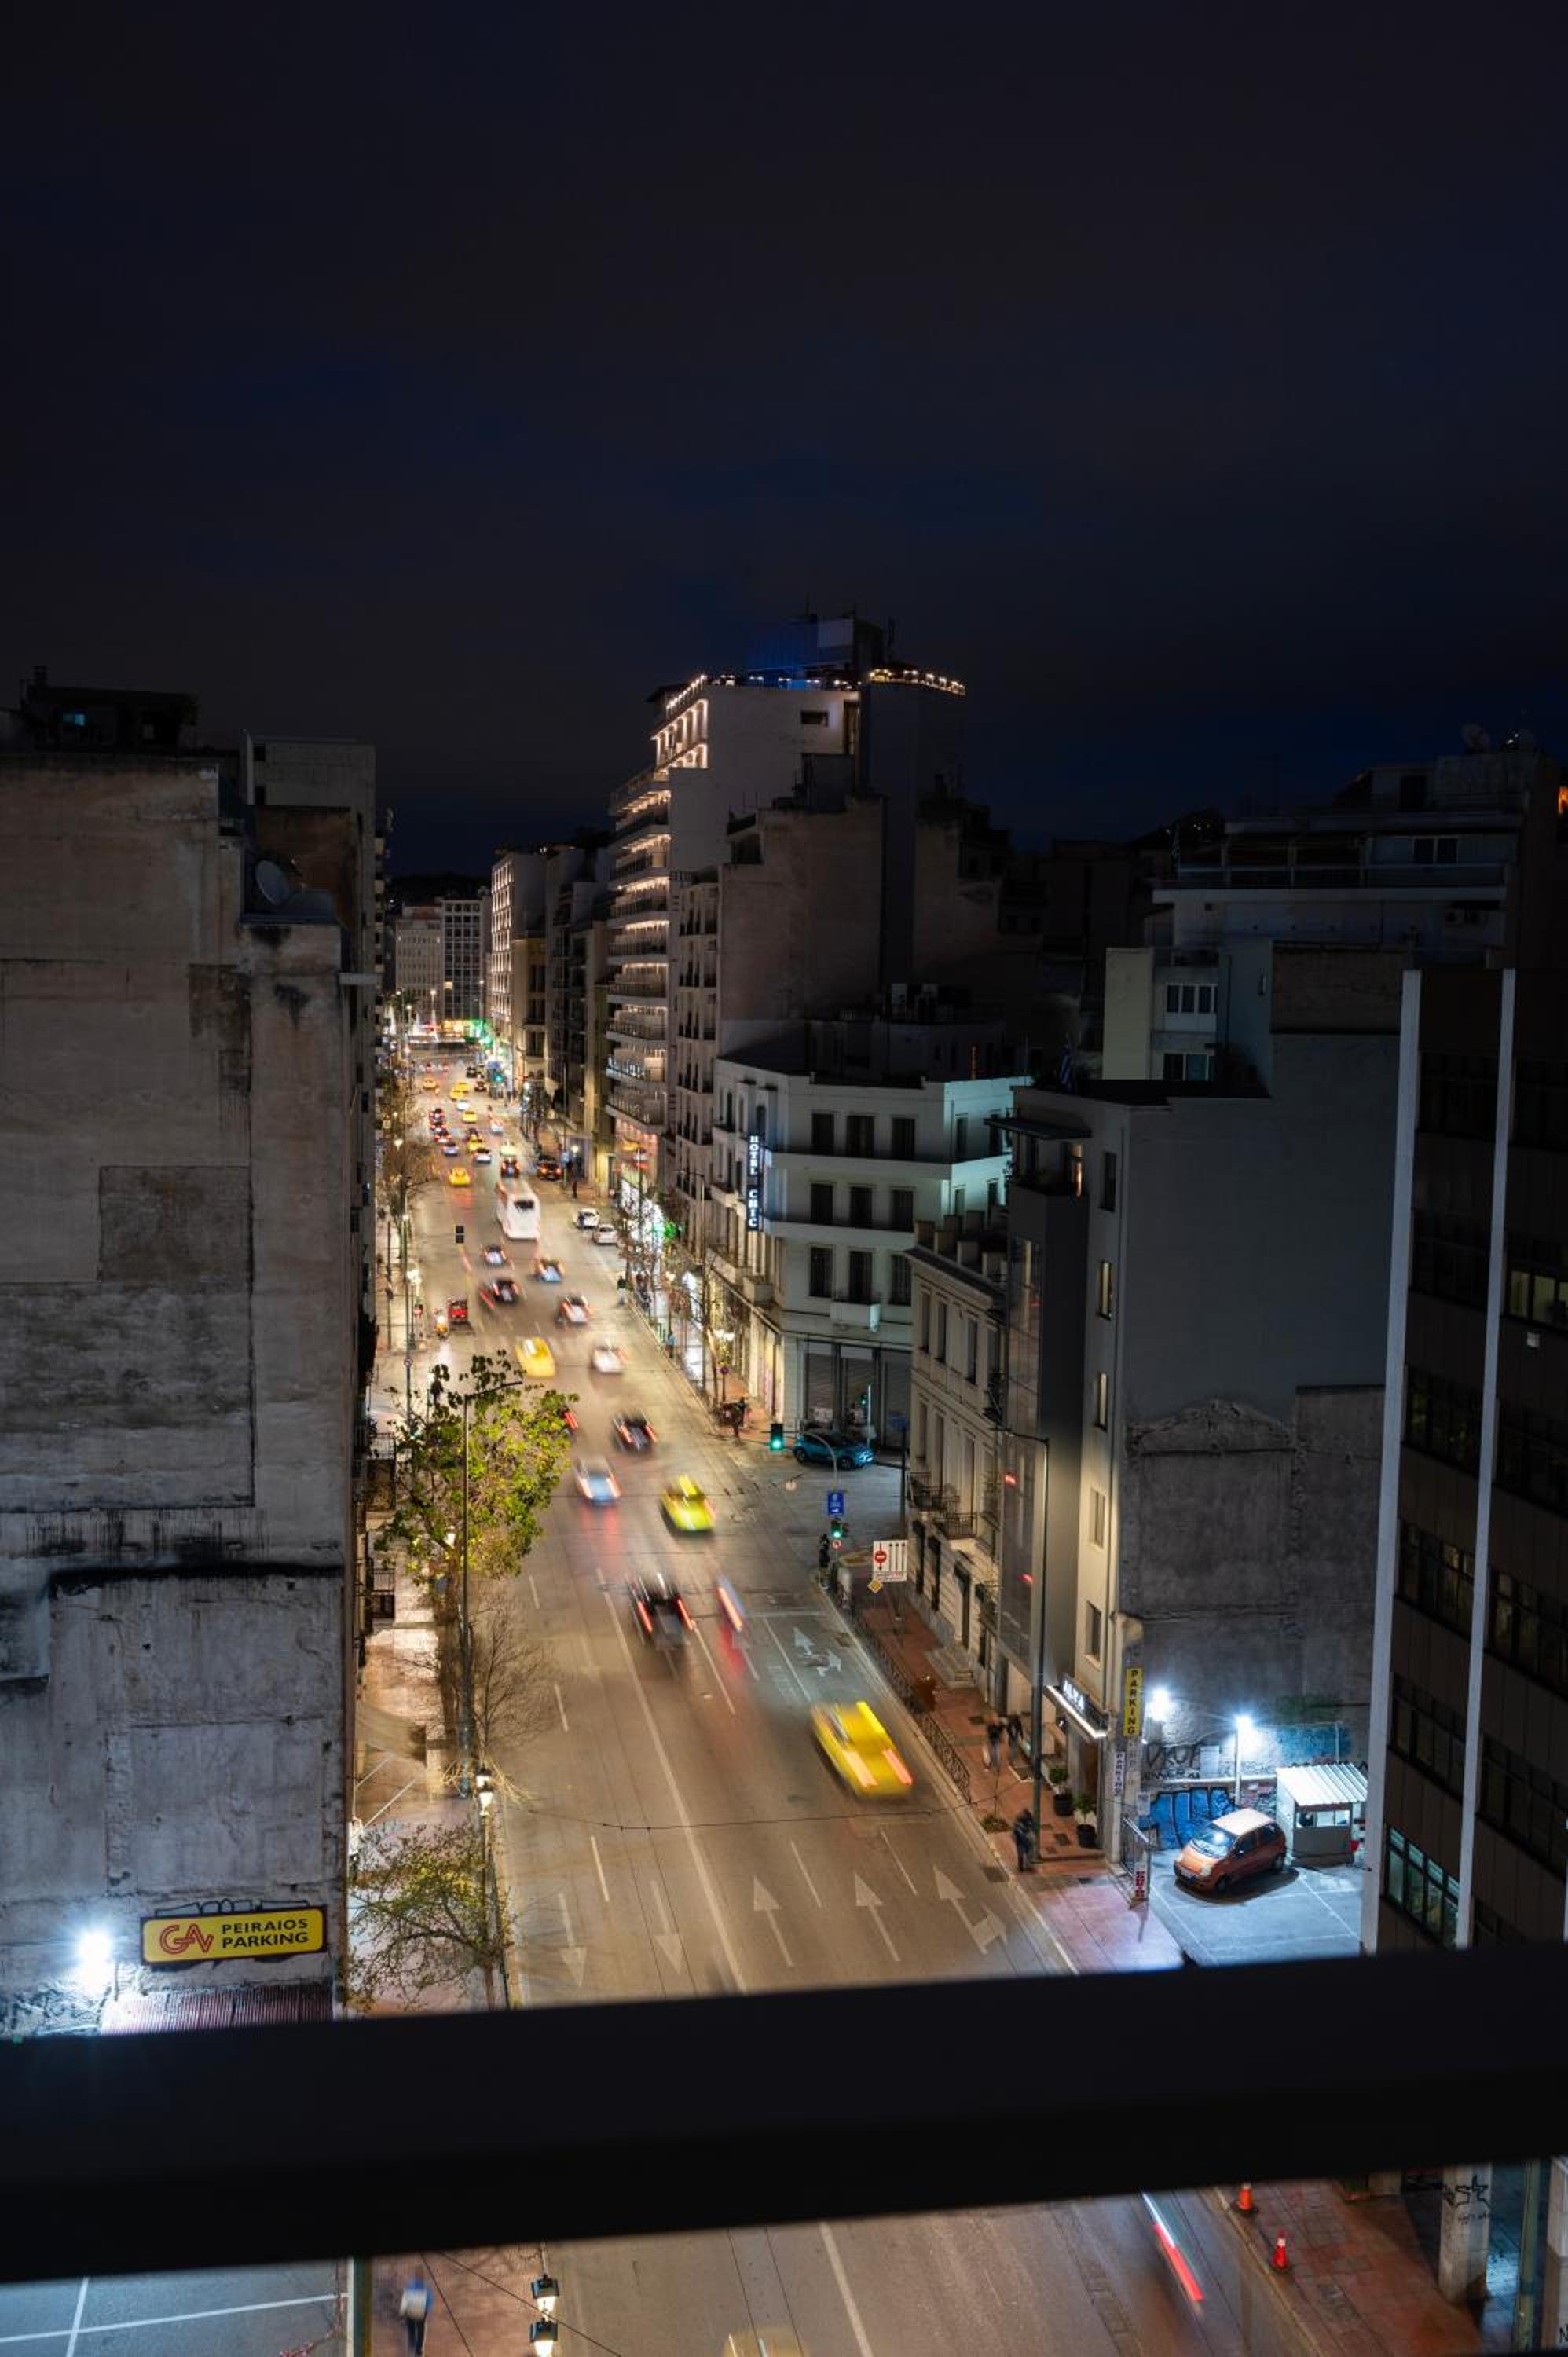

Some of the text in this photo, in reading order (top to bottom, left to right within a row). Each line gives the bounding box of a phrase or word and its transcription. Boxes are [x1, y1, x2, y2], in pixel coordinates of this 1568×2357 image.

[749, 1135, 759, 1175] HOTEL
[748, 1189, 758, 1227] CHIC
[1127, 1670, 1138, 1735] PARKING
[222, 1918, 309, 1935] PEIRAIOS
[222, 1931, 310, 1949] PARKING
